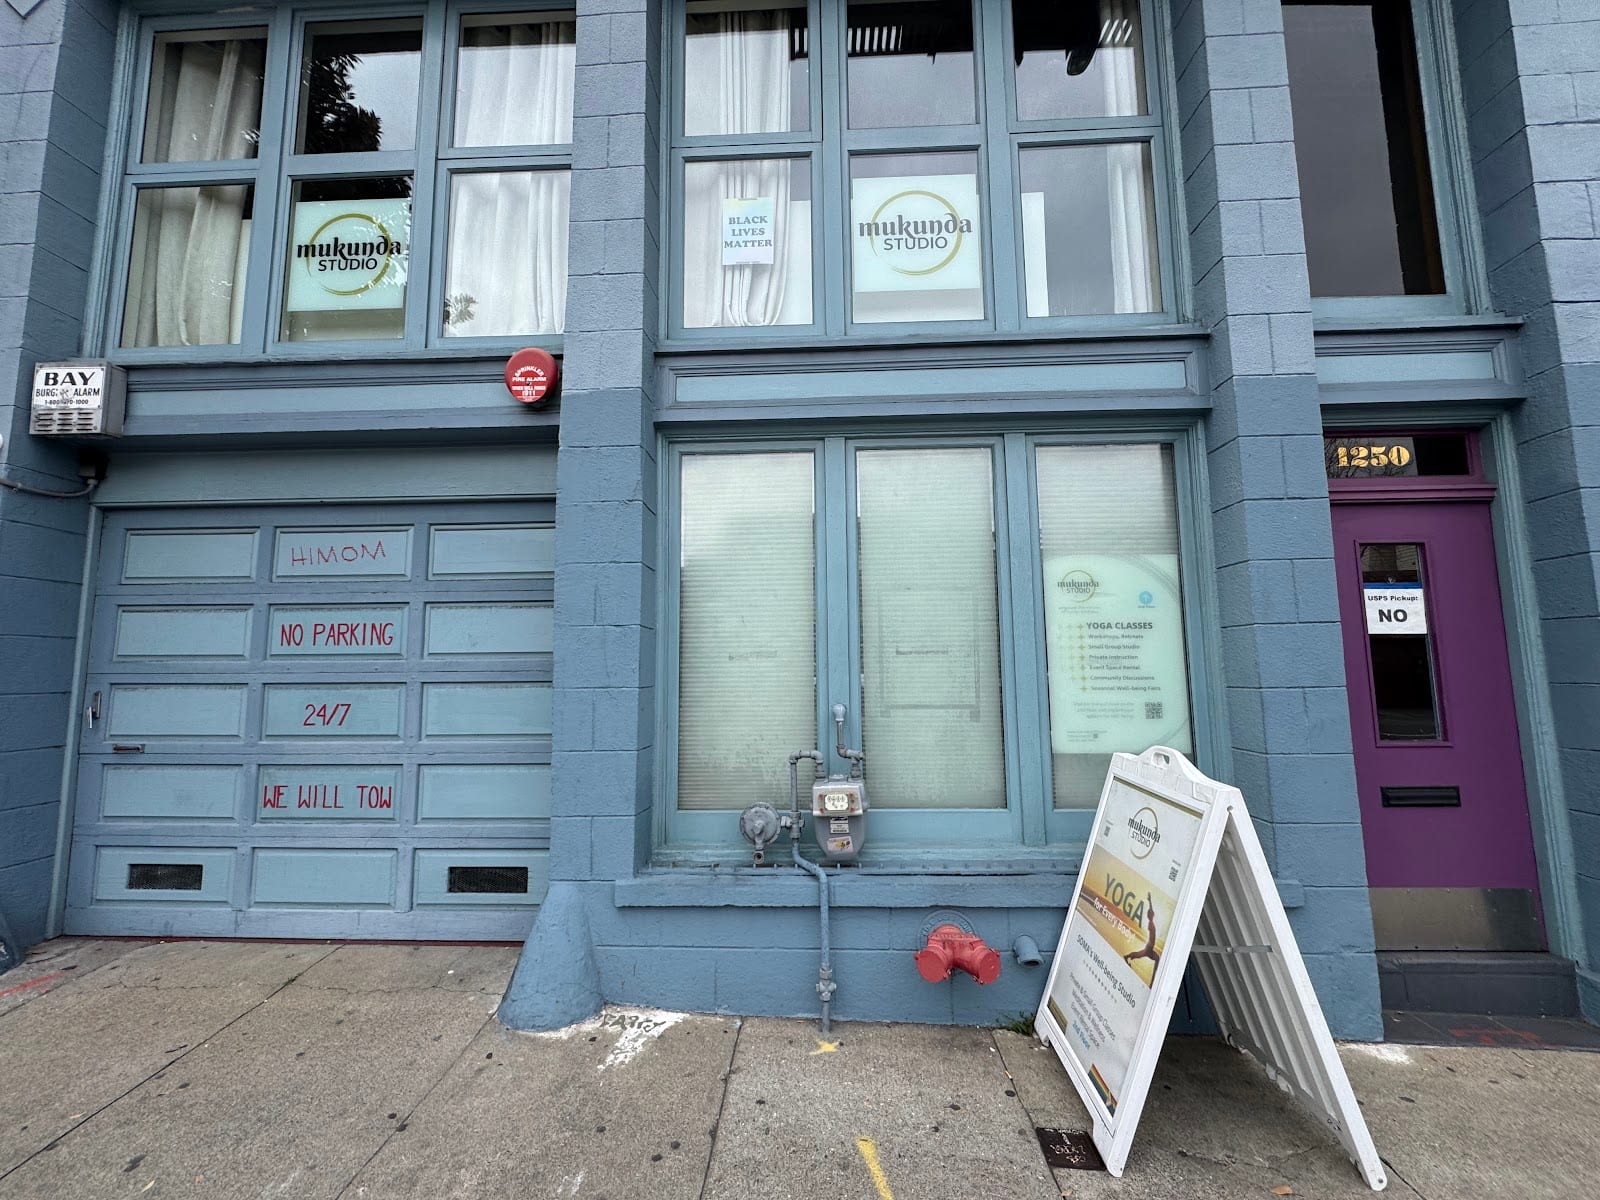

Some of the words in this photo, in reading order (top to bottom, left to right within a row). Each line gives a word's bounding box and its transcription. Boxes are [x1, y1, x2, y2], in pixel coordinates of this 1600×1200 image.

[728, 215, 768, 225] BLACK
[859, 212, 972, 238] mukunda
[731, 228, 765, 237] LIVES
[297, 236, 402, 260] mukunda
[724, 239, 773, 248] MATTER
[883, 236, 948, 250] STUDIO
[318, 258, 378, 271] STUDIO
[44, 372, 95, 386] BAY
[514, 366, 544, 377] SPRINKLER
[74, 388, 100, 396] ALARM
[1338, 446, 1410, 467] 1250
[1057, 579, 1100, 590] mukunda
[1379, 609, 1408, 622] NO
[280, 624, 304, 646] NO
[312, 623, 394, 646] PARKING
[304, 704, 351, 726] 24/7
[263, 786, 288, 808] WE
[298, 786, 344, 808] WILL
[356, 786, 392, 808] TOW
[1128, 817, 1160, 843] mukunda
[1130, 832, 1150, 848] STUDIO
[1104, 873, 1144, 928] YOGA
[1093, 897, 1102, 911] for
[1102, 906, 1118, 928] Every
[1076, 934, 1093, 957] SOMA's
[1093, 953, 1118, 990] Well-being
[1118, 980, 1136, 1008] Studio
